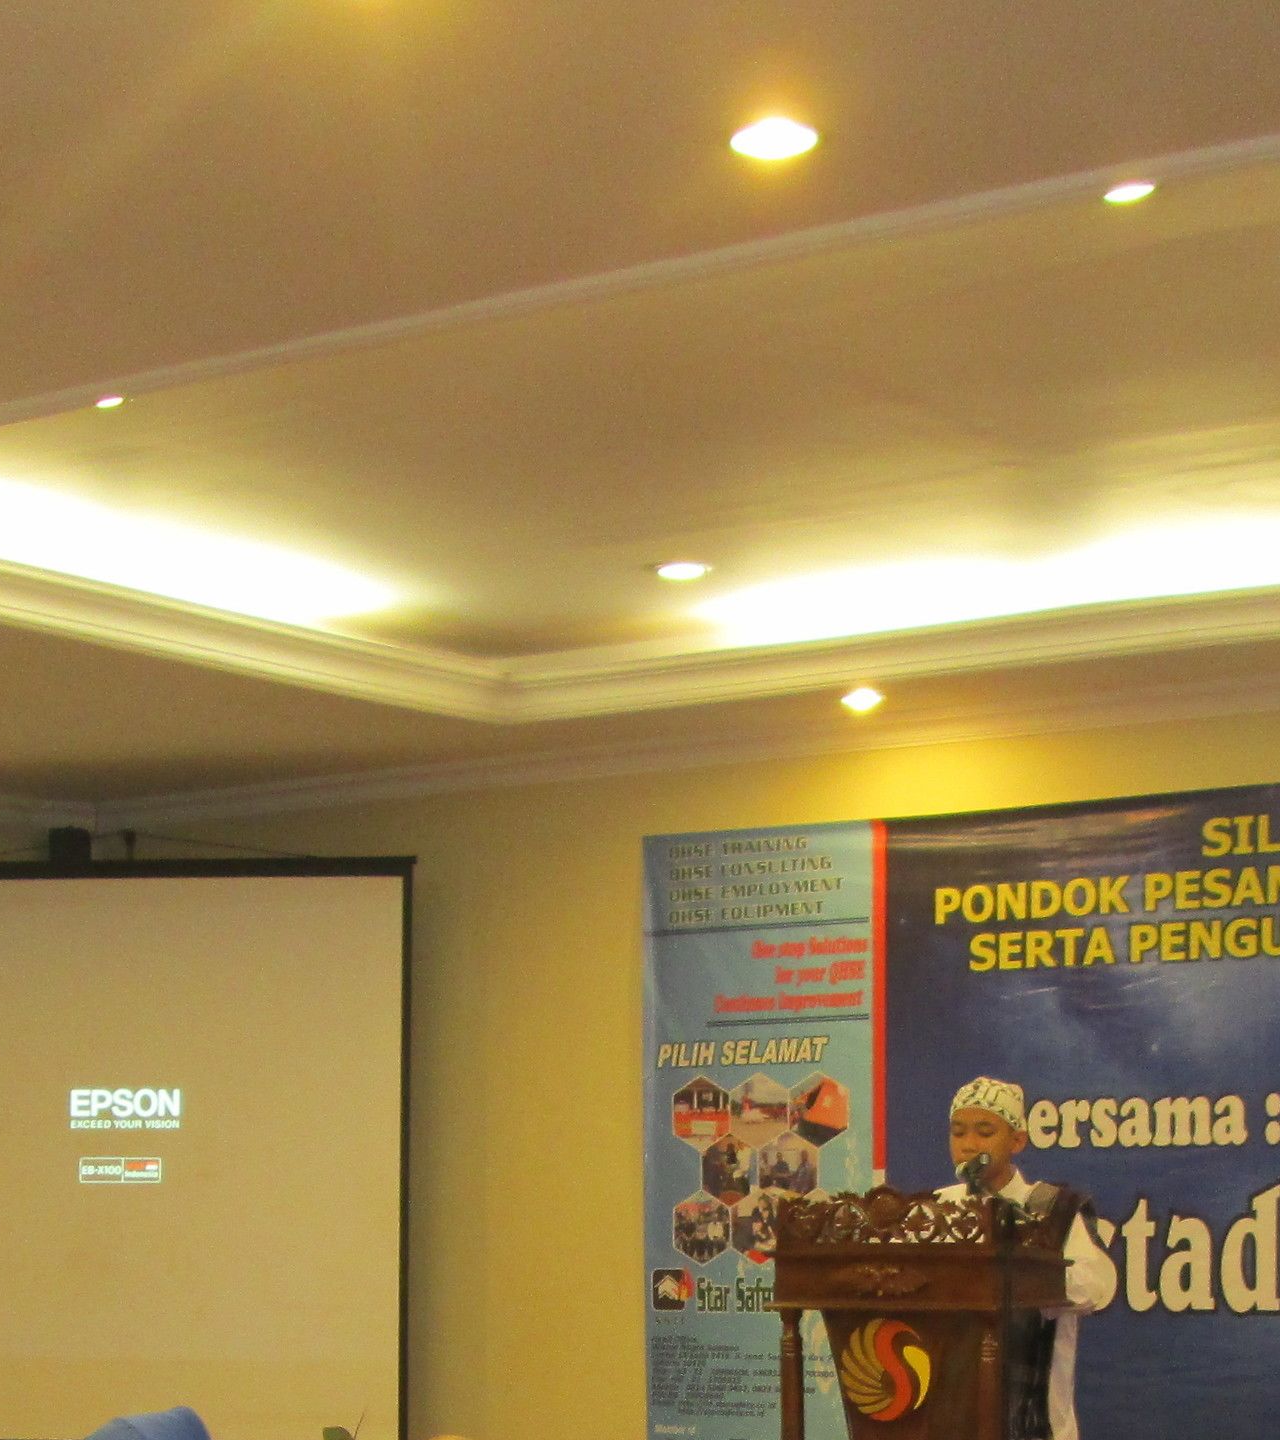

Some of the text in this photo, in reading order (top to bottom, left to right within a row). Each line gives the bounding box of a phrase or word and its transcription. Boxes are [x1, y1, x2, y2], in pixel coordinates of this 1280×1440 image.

[721, 877, 845, 899] EMPLOYMENT
[934, 874, 1129, 925] PONDOK
[968, 926, 1115, 972] SERTA
[657, 1036, 831, 1068] PILIH SELAMAT
[70, 1088, 181, 1117] EPSON
[70, 1119, 180, 1129] EXCEED YOUR VISION
[1027, 1092, 1248, 1149] ersama
[697, 1277, 730, 1312] Star
